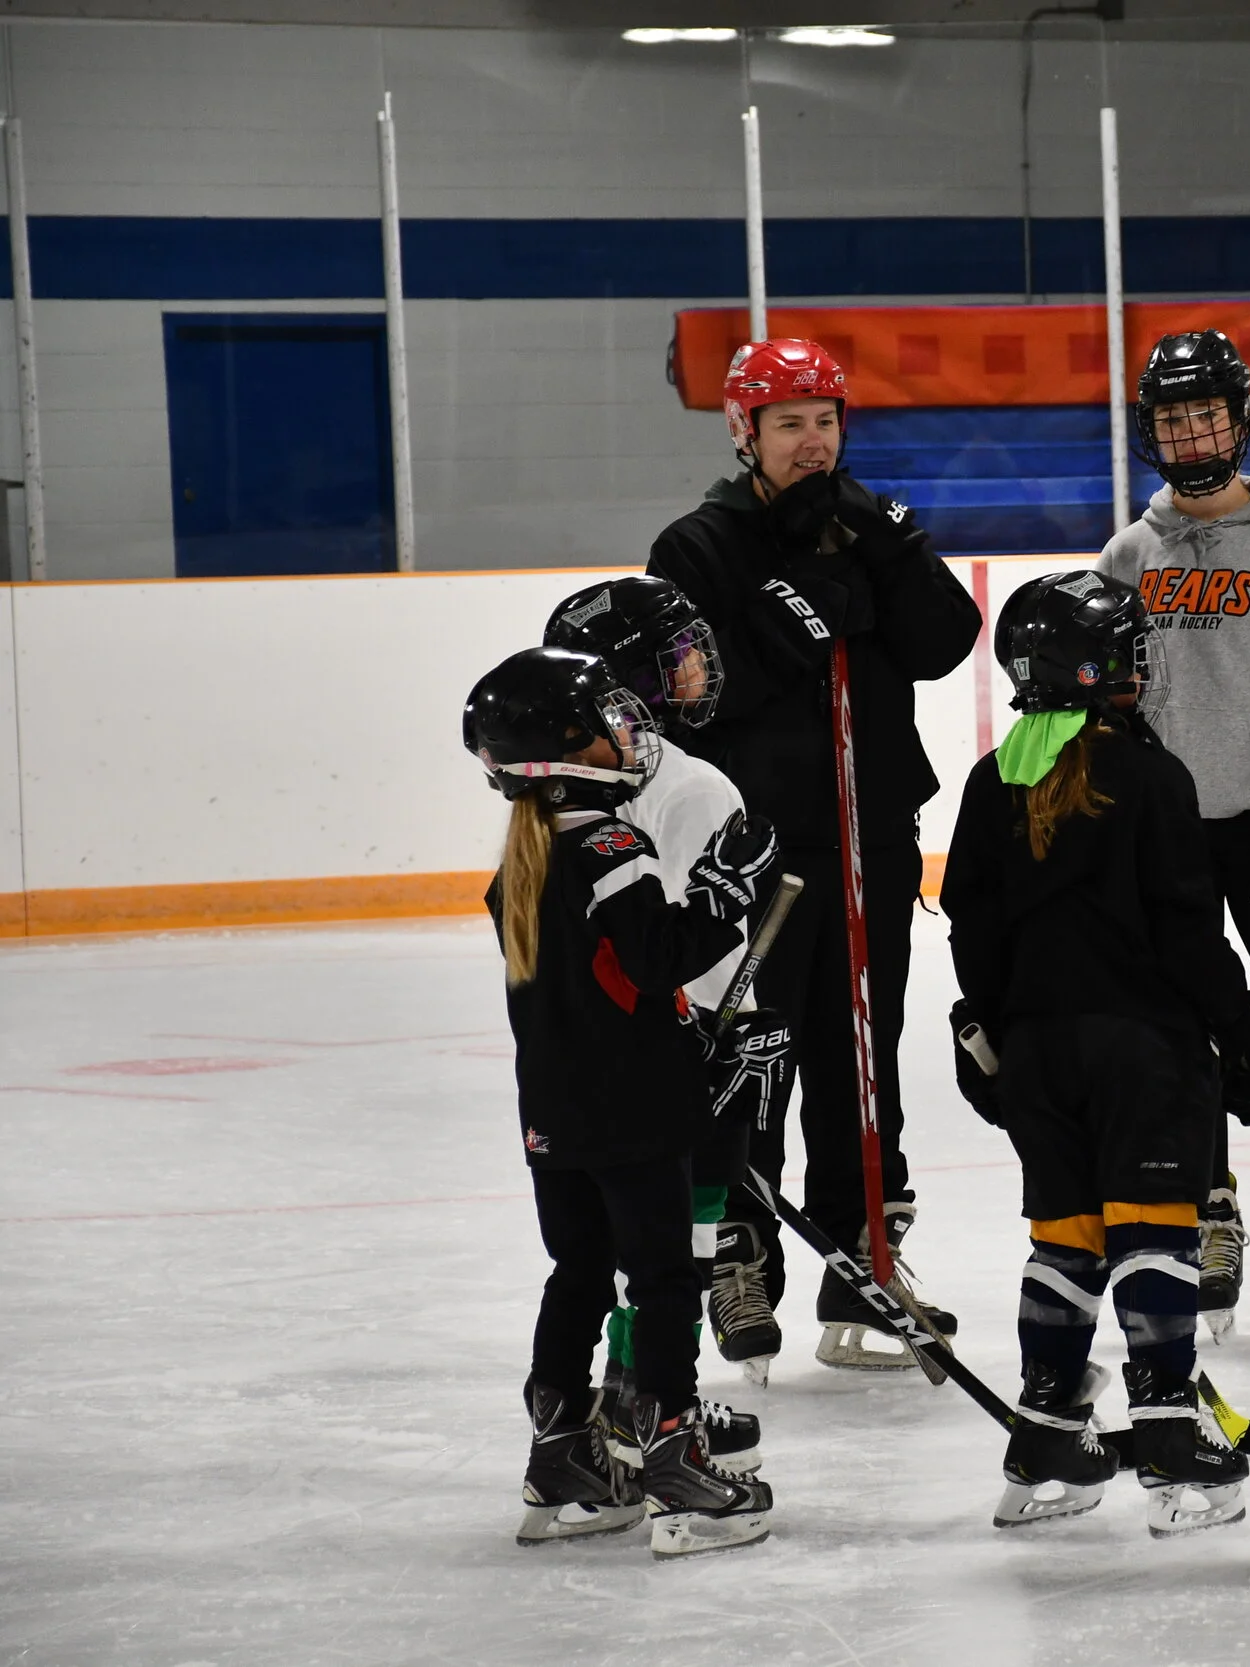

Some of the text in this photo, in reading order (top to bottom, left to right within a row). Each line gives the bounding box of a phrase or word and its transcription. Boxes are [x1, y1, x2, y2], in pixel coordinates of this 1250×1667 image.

[1160, 374, 1197, 386] BAUER
[1179, 616, 1224, 630] HOCKEY
[614, 631, 641, 650] CCM
[1015, 659, 1029, 678] 17
[696, 865, 752, 906] BAUER
[824, 1247, 936, 1347] CCM
